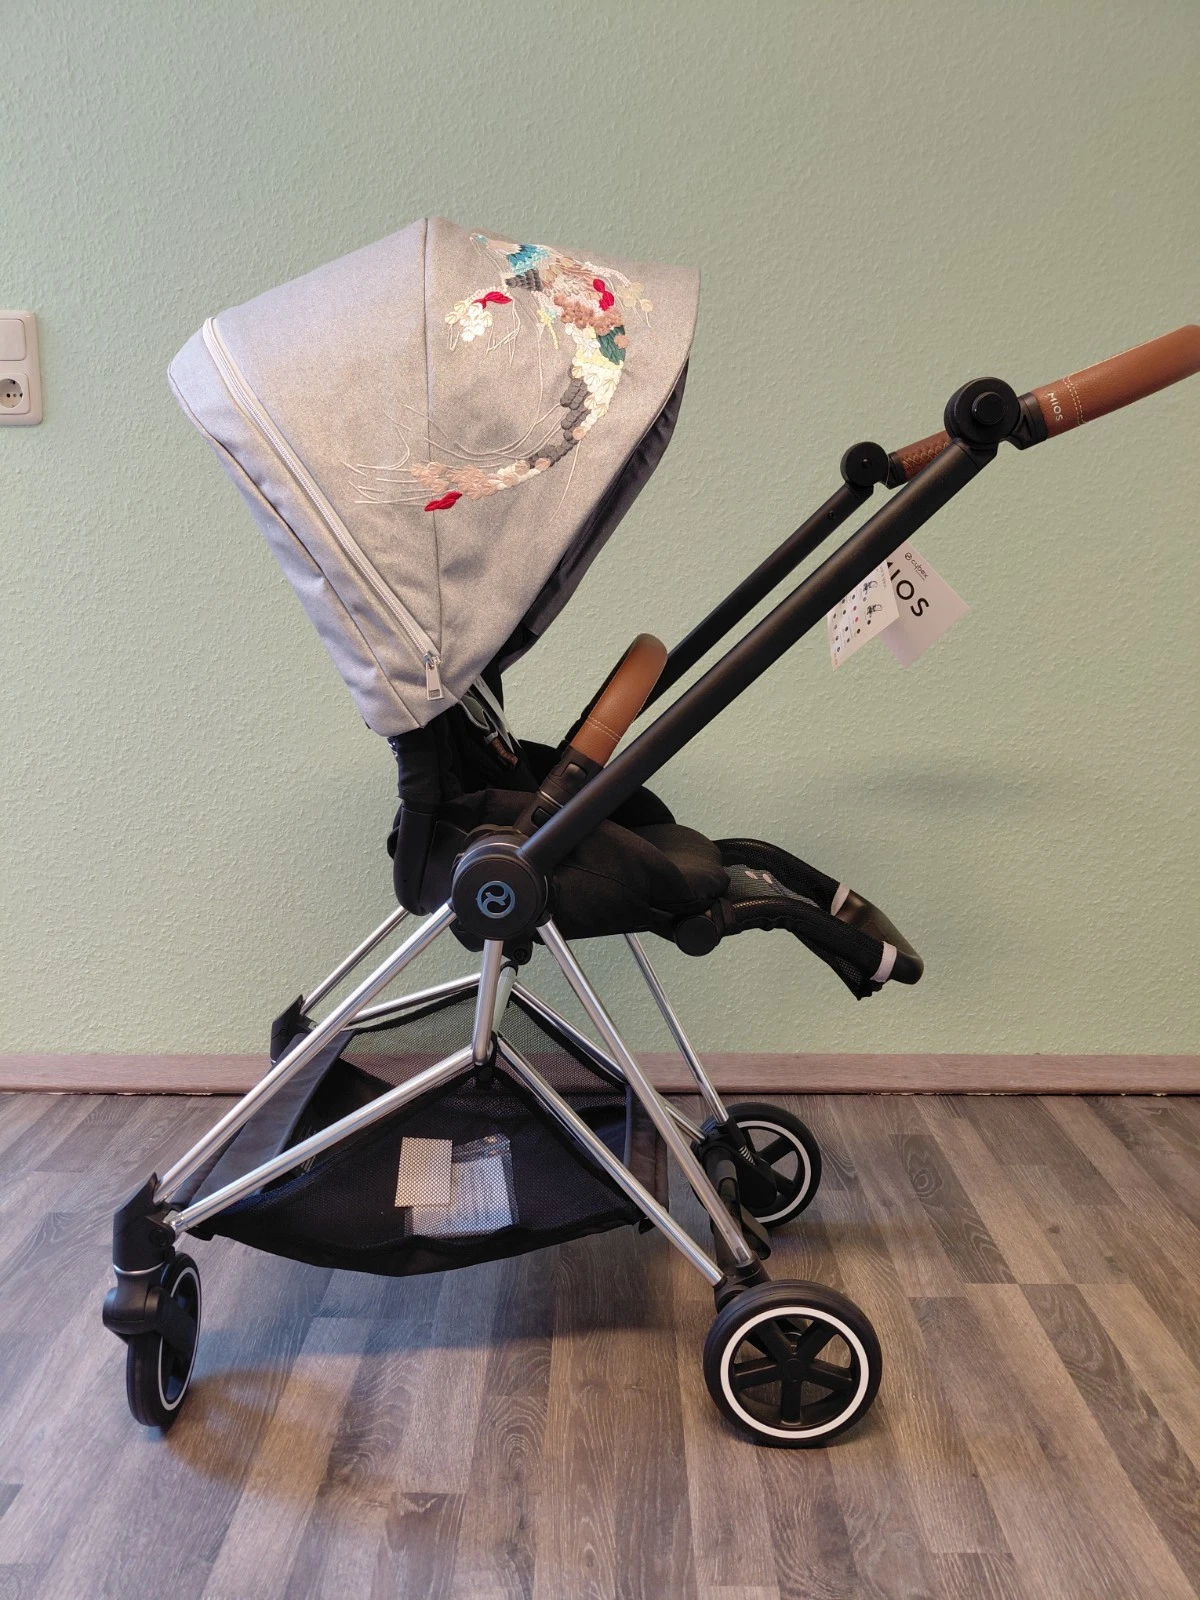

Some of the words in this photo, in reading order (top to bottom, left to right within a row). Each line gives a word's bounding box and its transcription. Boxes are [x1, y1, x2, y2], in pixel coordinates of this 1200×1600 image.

[1047, 392, 1063, 421] MIOS
[911, 560, 928, 579] cybex
[886, 562, 929, 617] IOS
